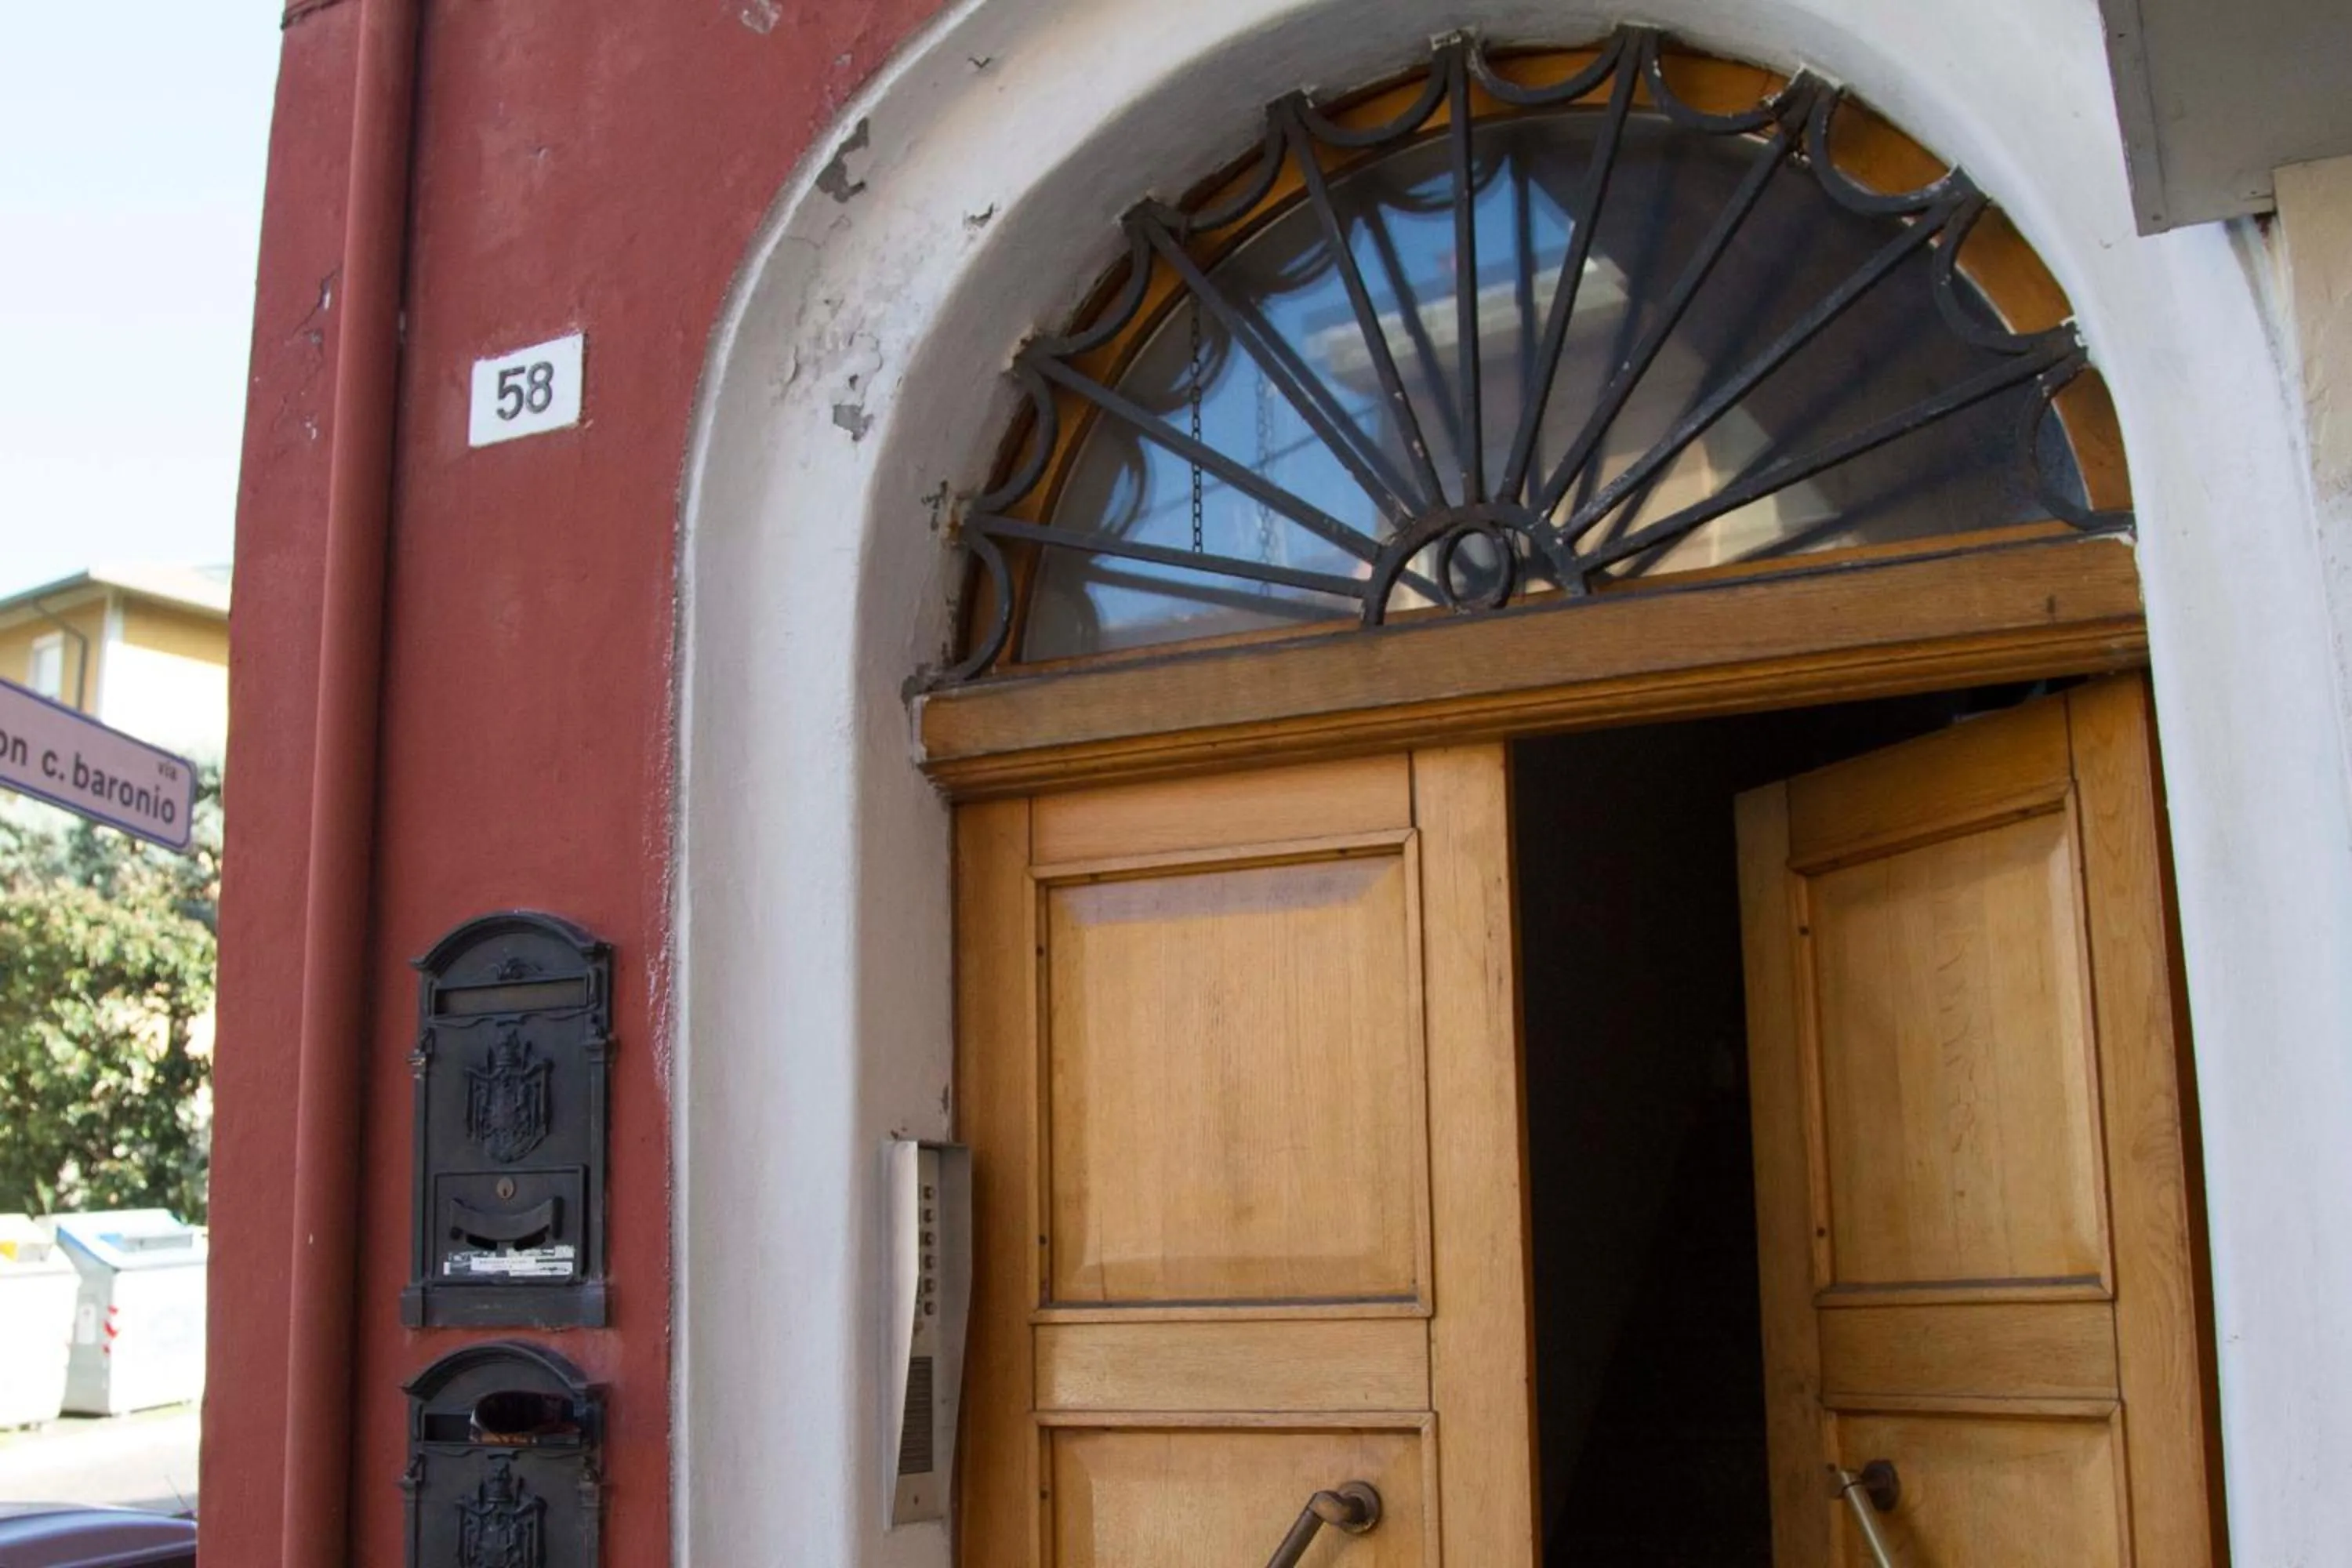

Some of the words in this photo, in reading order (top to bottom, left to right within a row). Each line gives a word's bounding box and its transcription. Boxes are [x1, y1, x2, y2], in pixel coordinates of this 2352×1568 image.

[496, 361, 554, 421] 58
[71, 752, 176, 824] baronio
[158, 760, 177, 782] via
